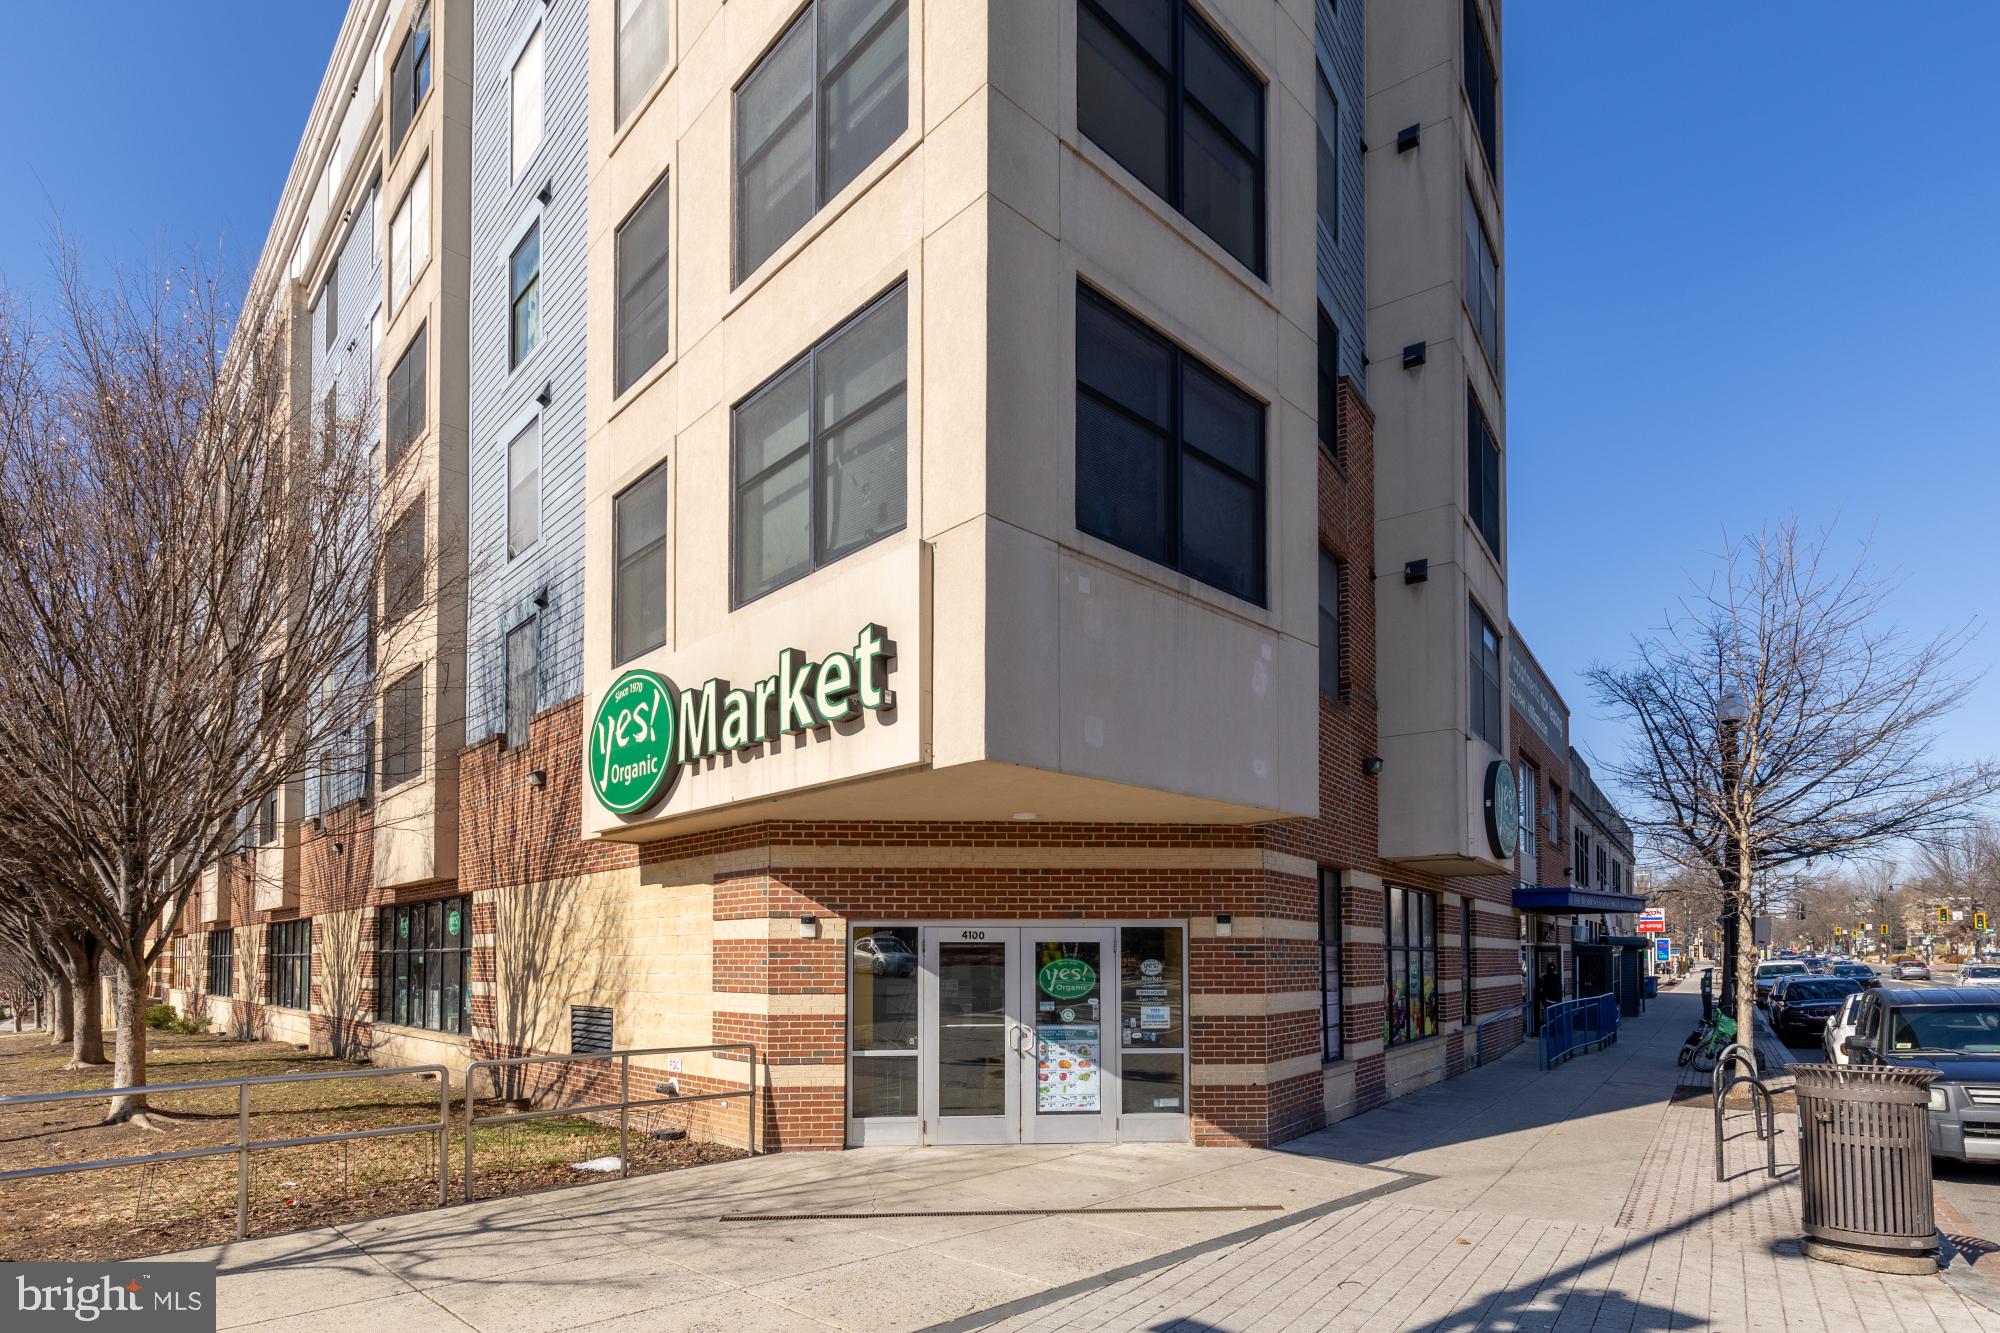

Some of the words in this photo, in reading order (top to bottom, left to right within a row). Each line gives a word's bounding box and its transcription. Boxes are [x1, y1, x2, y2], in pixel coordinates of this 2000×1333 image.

[614, 687, 629, 703] Since
[629, 681, 643, 693] 1970
[677, 622, 890, 765] Market
[610, 753, 659, 786] Organic
[961, 930, 985, 940] 4100
[1045, 966, 1088, 992] yes!
[1056, 984, 1088, 992] Organic
[669, 1059, 680, 1071] FDC
